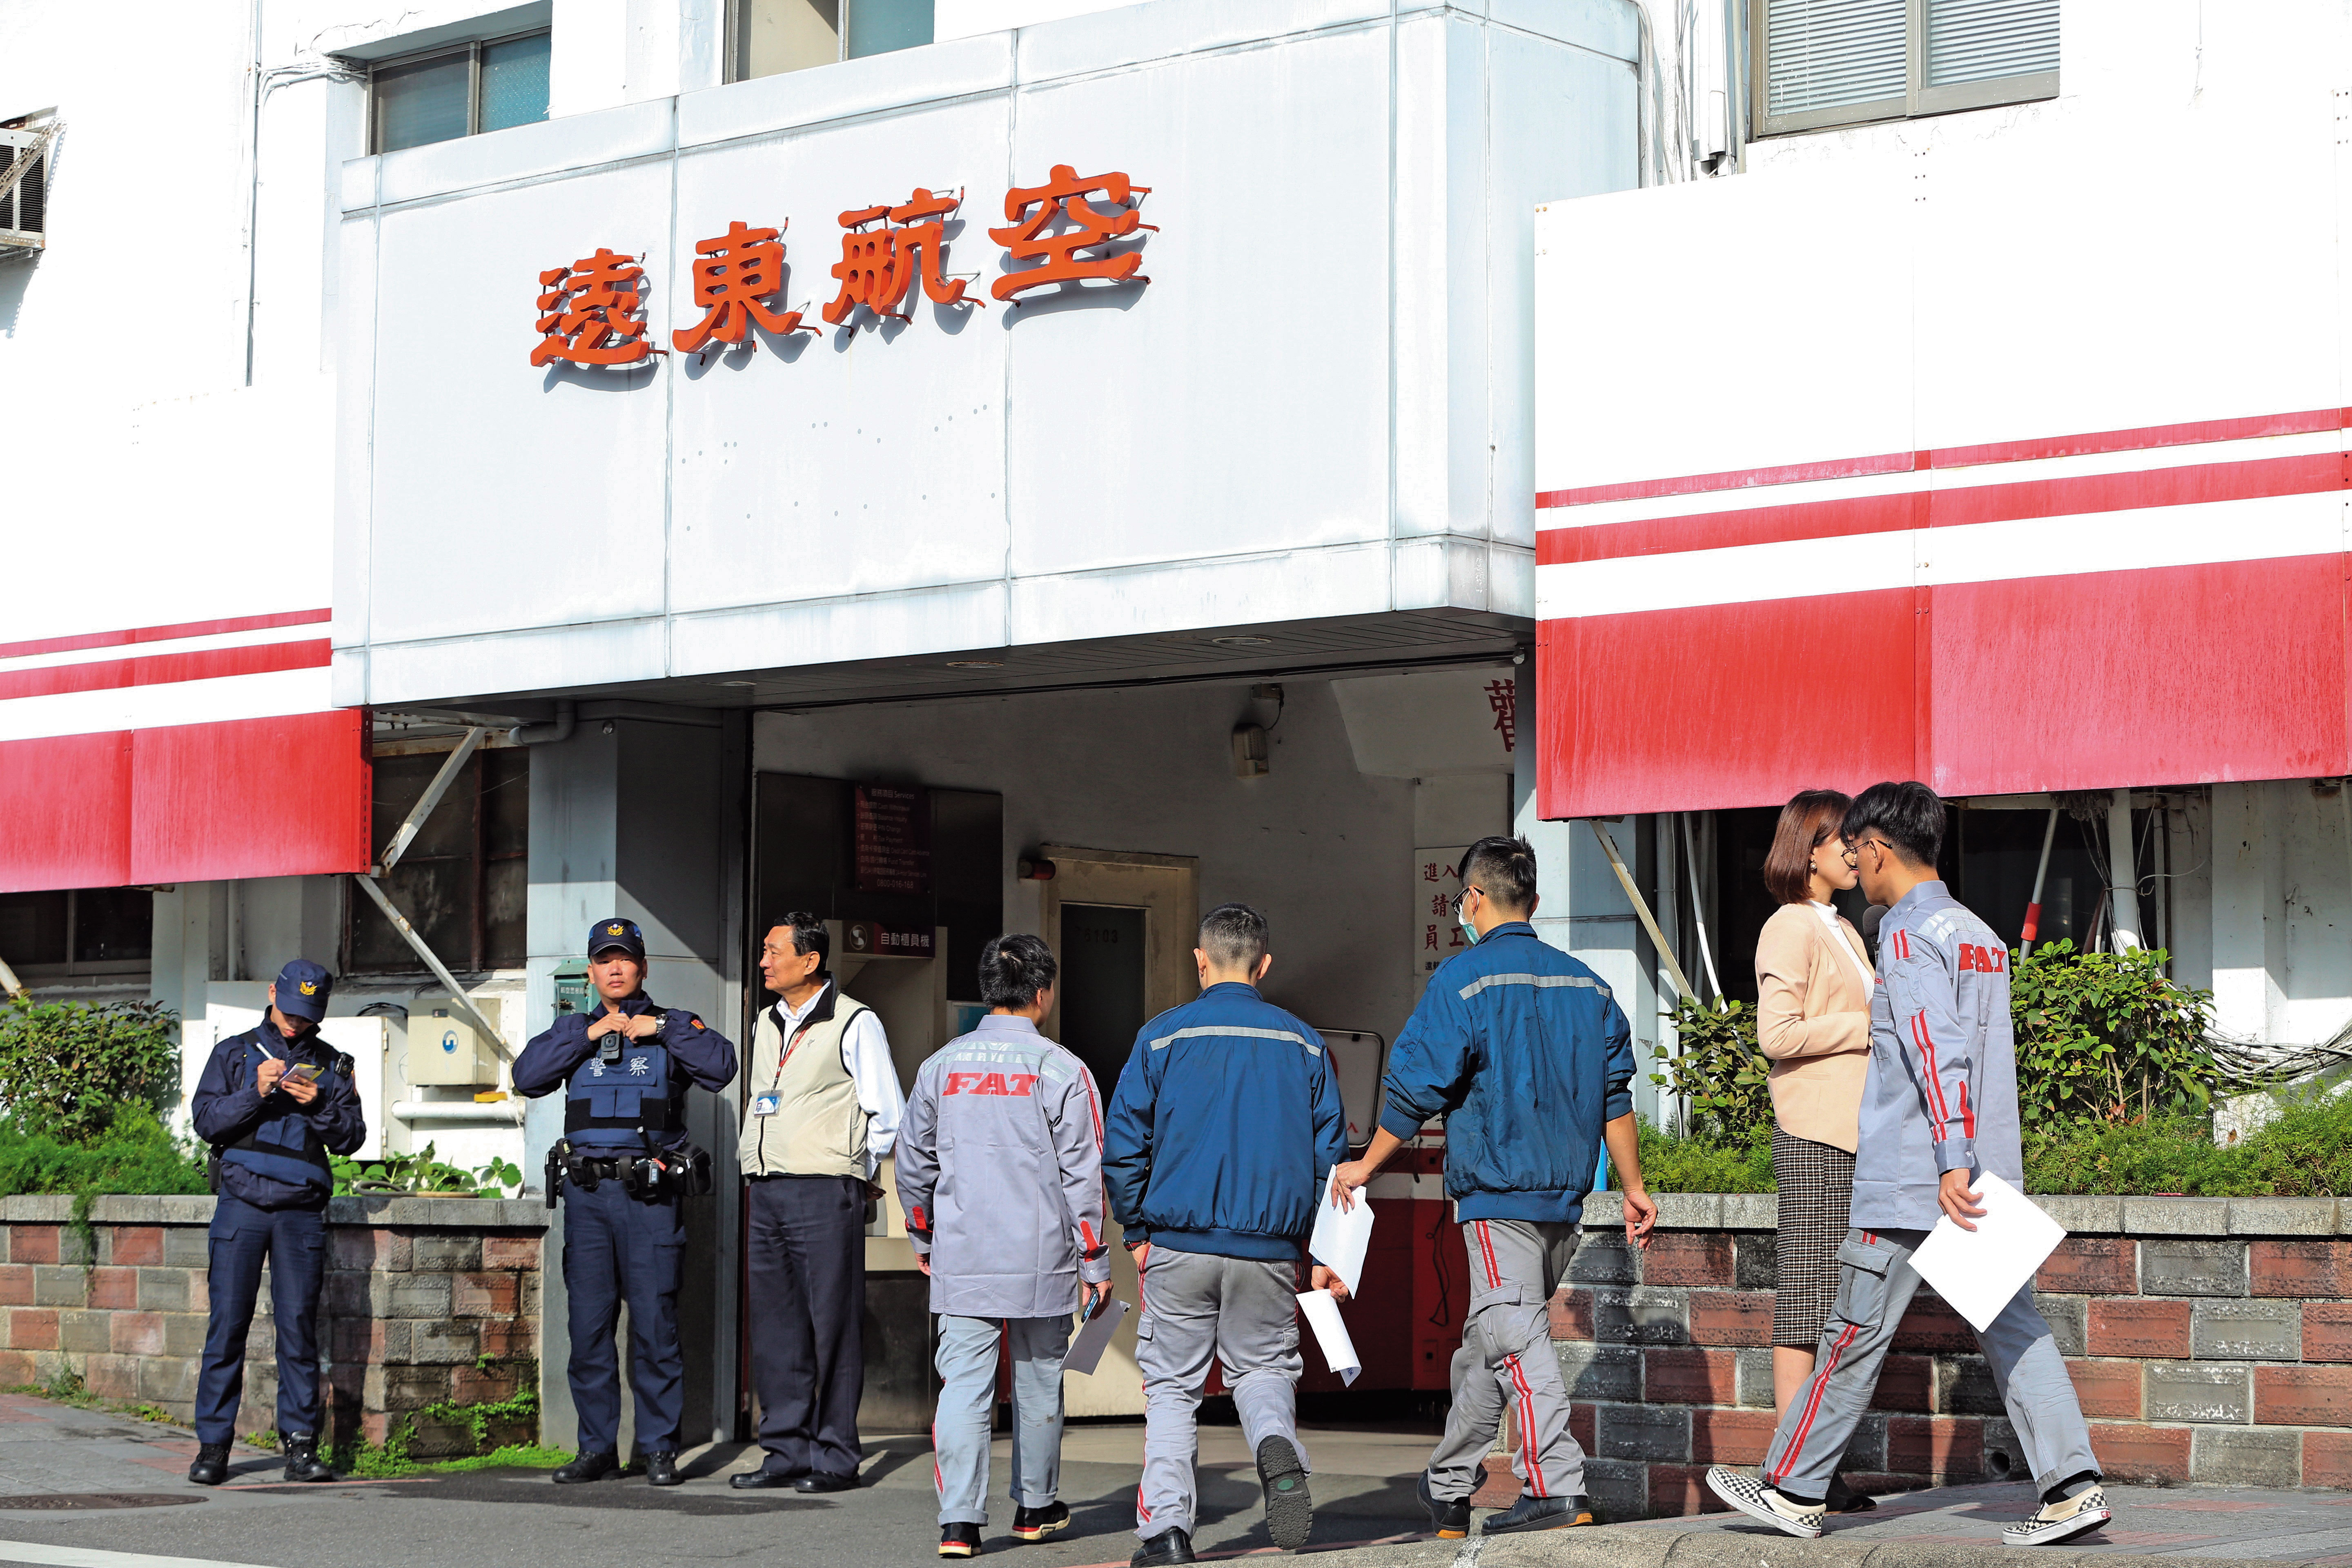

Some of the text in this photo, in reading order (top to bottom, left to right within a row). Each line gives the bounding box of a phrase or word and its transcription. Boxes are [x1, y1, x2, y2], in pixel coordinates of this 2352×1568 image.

[530, 164, 1143, 368] 遠東航空
[894, 791, 915, 800] Services
[1424, 862, 1458, 882] 進入
[880, 932, 930, 947] 自動櫃員機
[1424, 924, 1465, 951] 員工
[1959, 943, 2007, 973] FAT
[942, 1072, 1040, 1097] FAT
